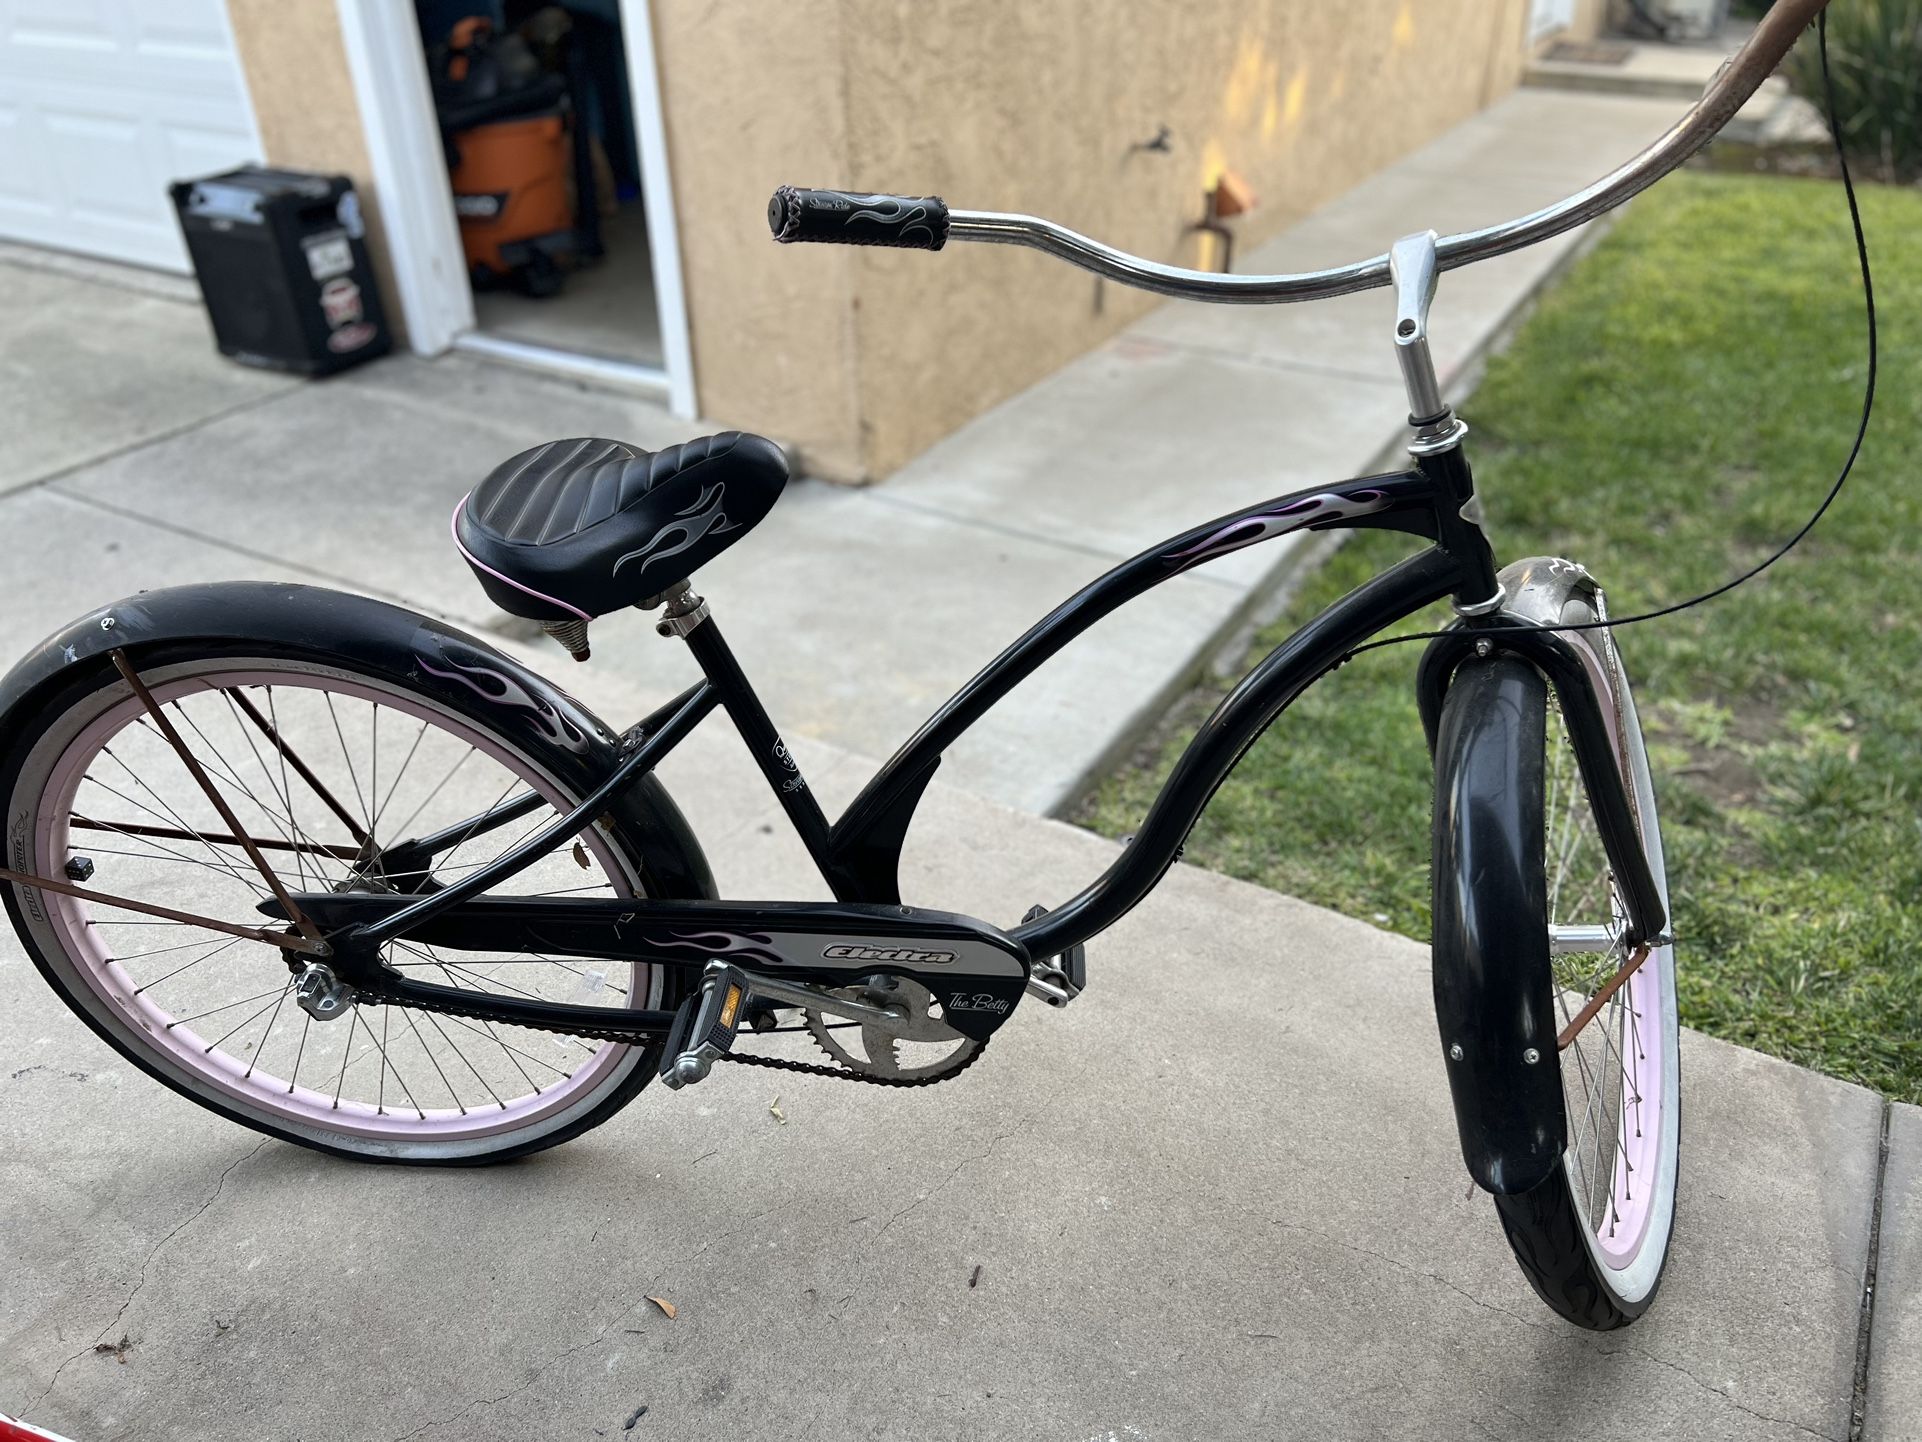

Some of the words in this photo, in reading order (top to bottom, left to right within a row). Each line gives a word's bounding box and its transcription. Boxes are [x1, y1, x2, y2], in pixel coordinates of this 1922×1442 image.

[823, 943, 957, 964] Electra
[949, 992, 969, 1009] The
[971, 993, 1010, 1015] Betty
